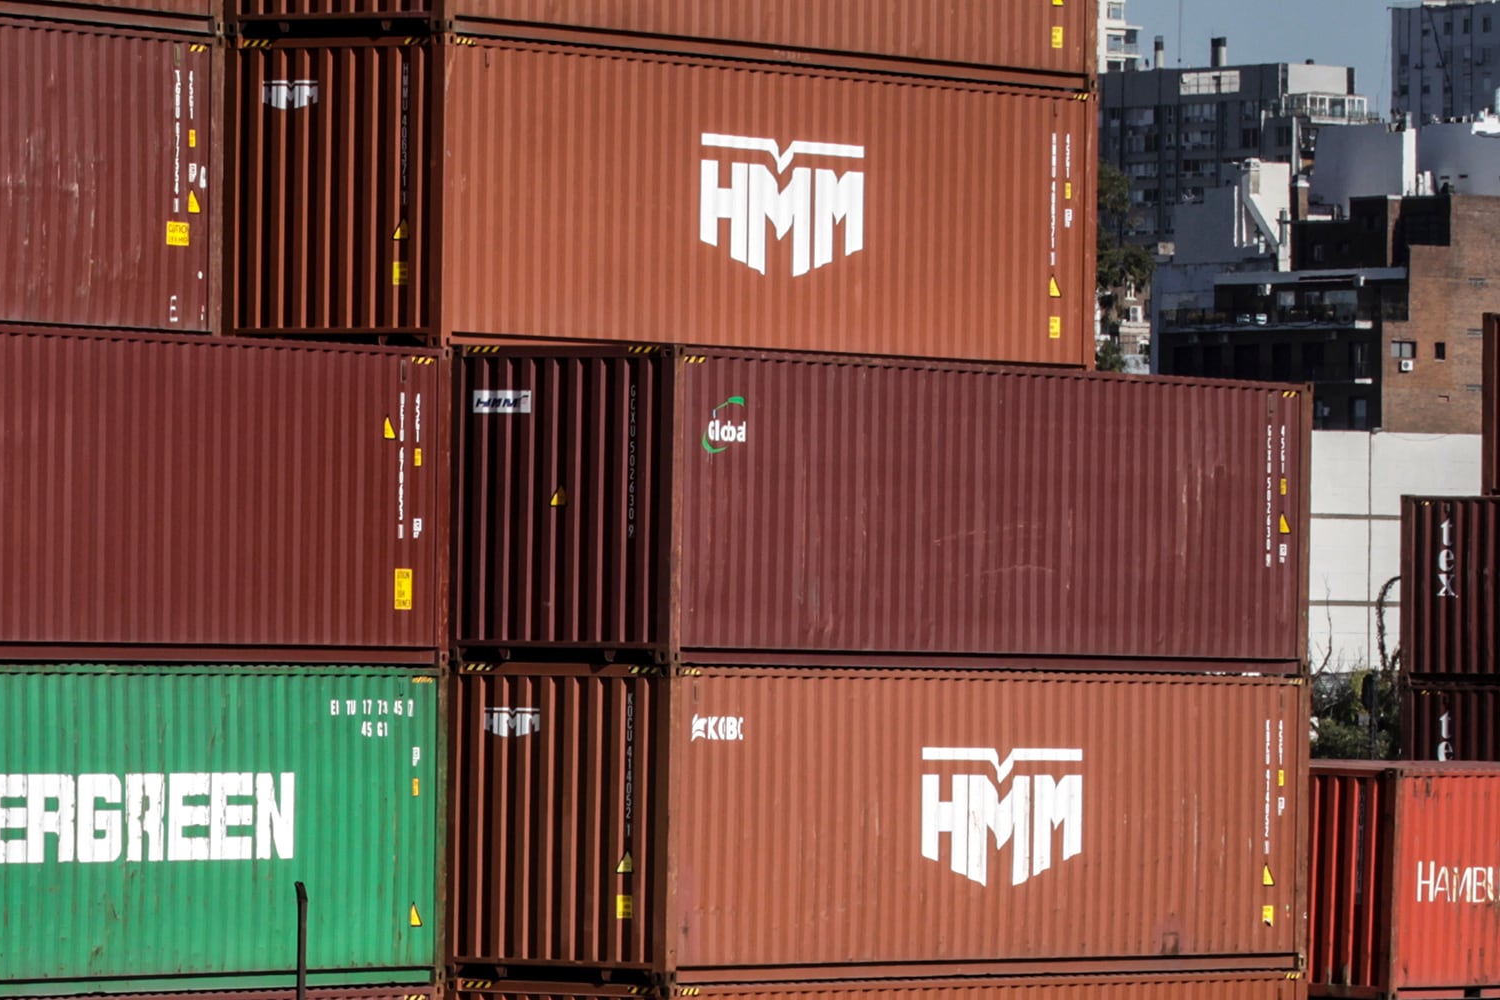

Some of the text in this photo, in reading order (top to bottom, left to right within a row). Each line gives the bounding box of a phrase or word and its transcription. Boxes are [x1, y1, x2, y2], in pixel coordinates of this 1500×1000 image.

[262, 80, 318, 110] HMM
[701, 133, 864, 276] HMM
[485, 707, 540, 737] HMM
[922, 747, 1082, 886] HMM
